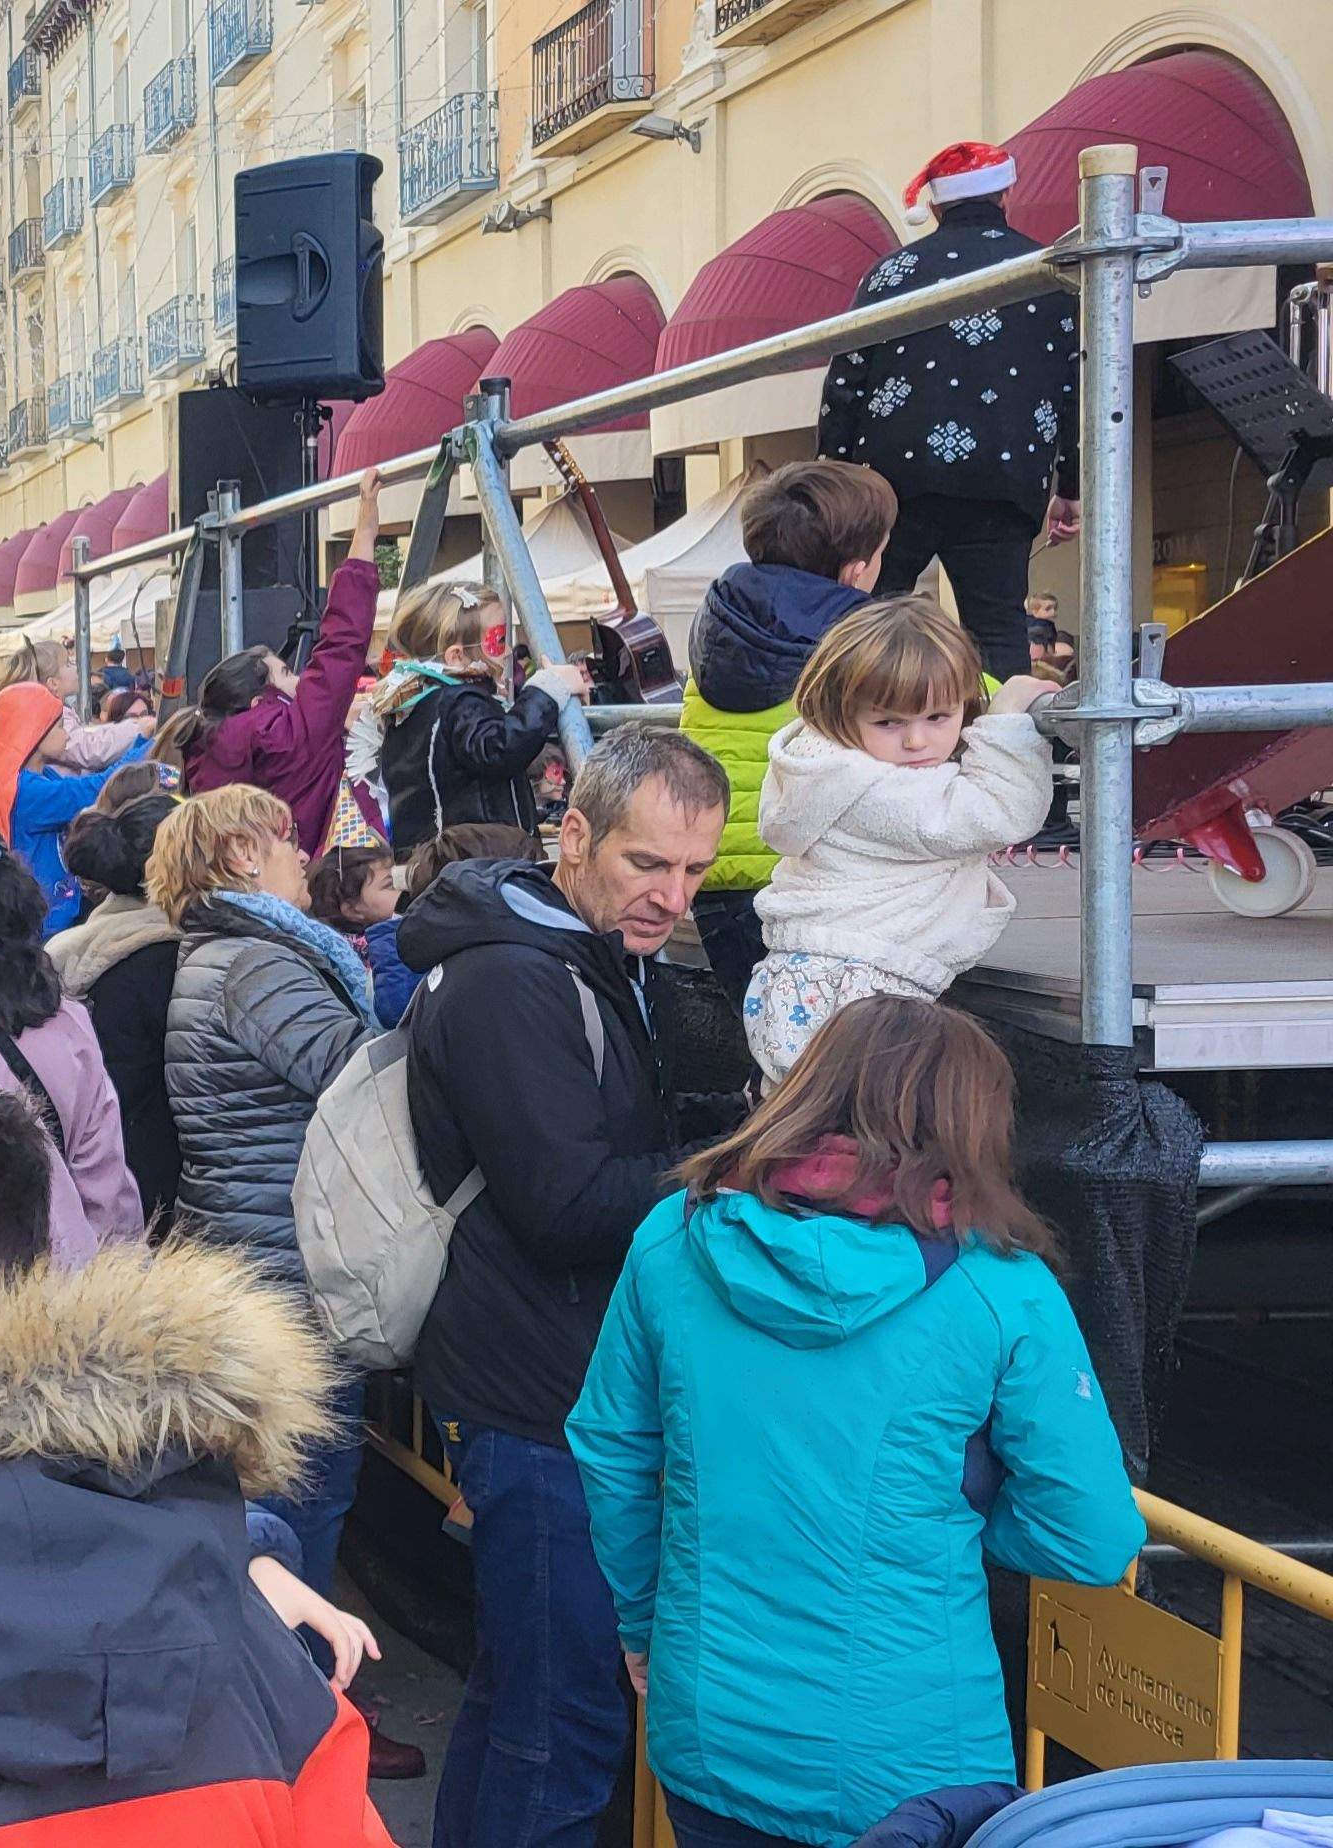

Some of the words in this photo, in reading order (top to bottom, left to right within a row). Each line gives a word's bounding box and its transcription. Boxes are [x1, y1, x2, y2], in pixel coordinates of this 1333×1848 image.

[1095, 1680, 1116, 1708] de
[1119, 1689, 1184, 1748] Huesca
[1096, 1645, 1213, 1728] Ayuntamiento
